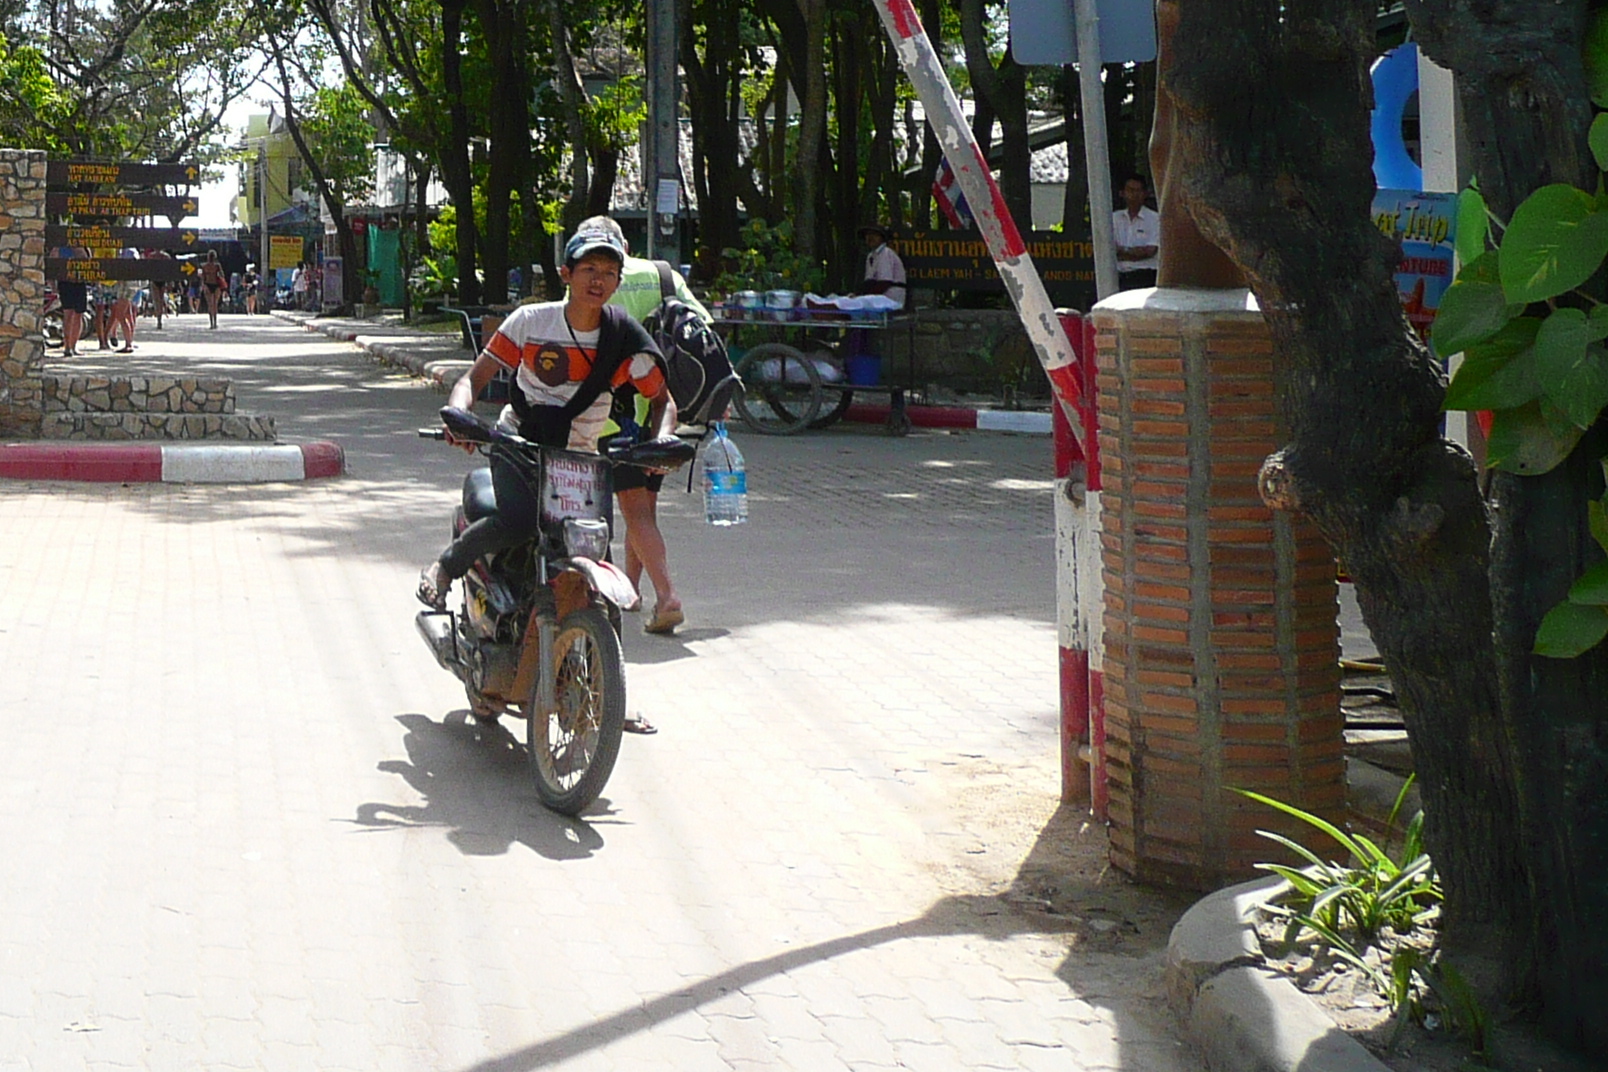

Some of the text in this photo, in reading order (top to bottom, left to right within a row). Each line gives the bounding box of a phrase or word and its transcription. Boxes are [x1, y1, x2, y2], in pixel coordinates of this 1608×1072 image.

[1405, 201, 1449, 252] Trip
[919, 268, 951, 279] LAEM
[953, 268, 974, 280] YAH
